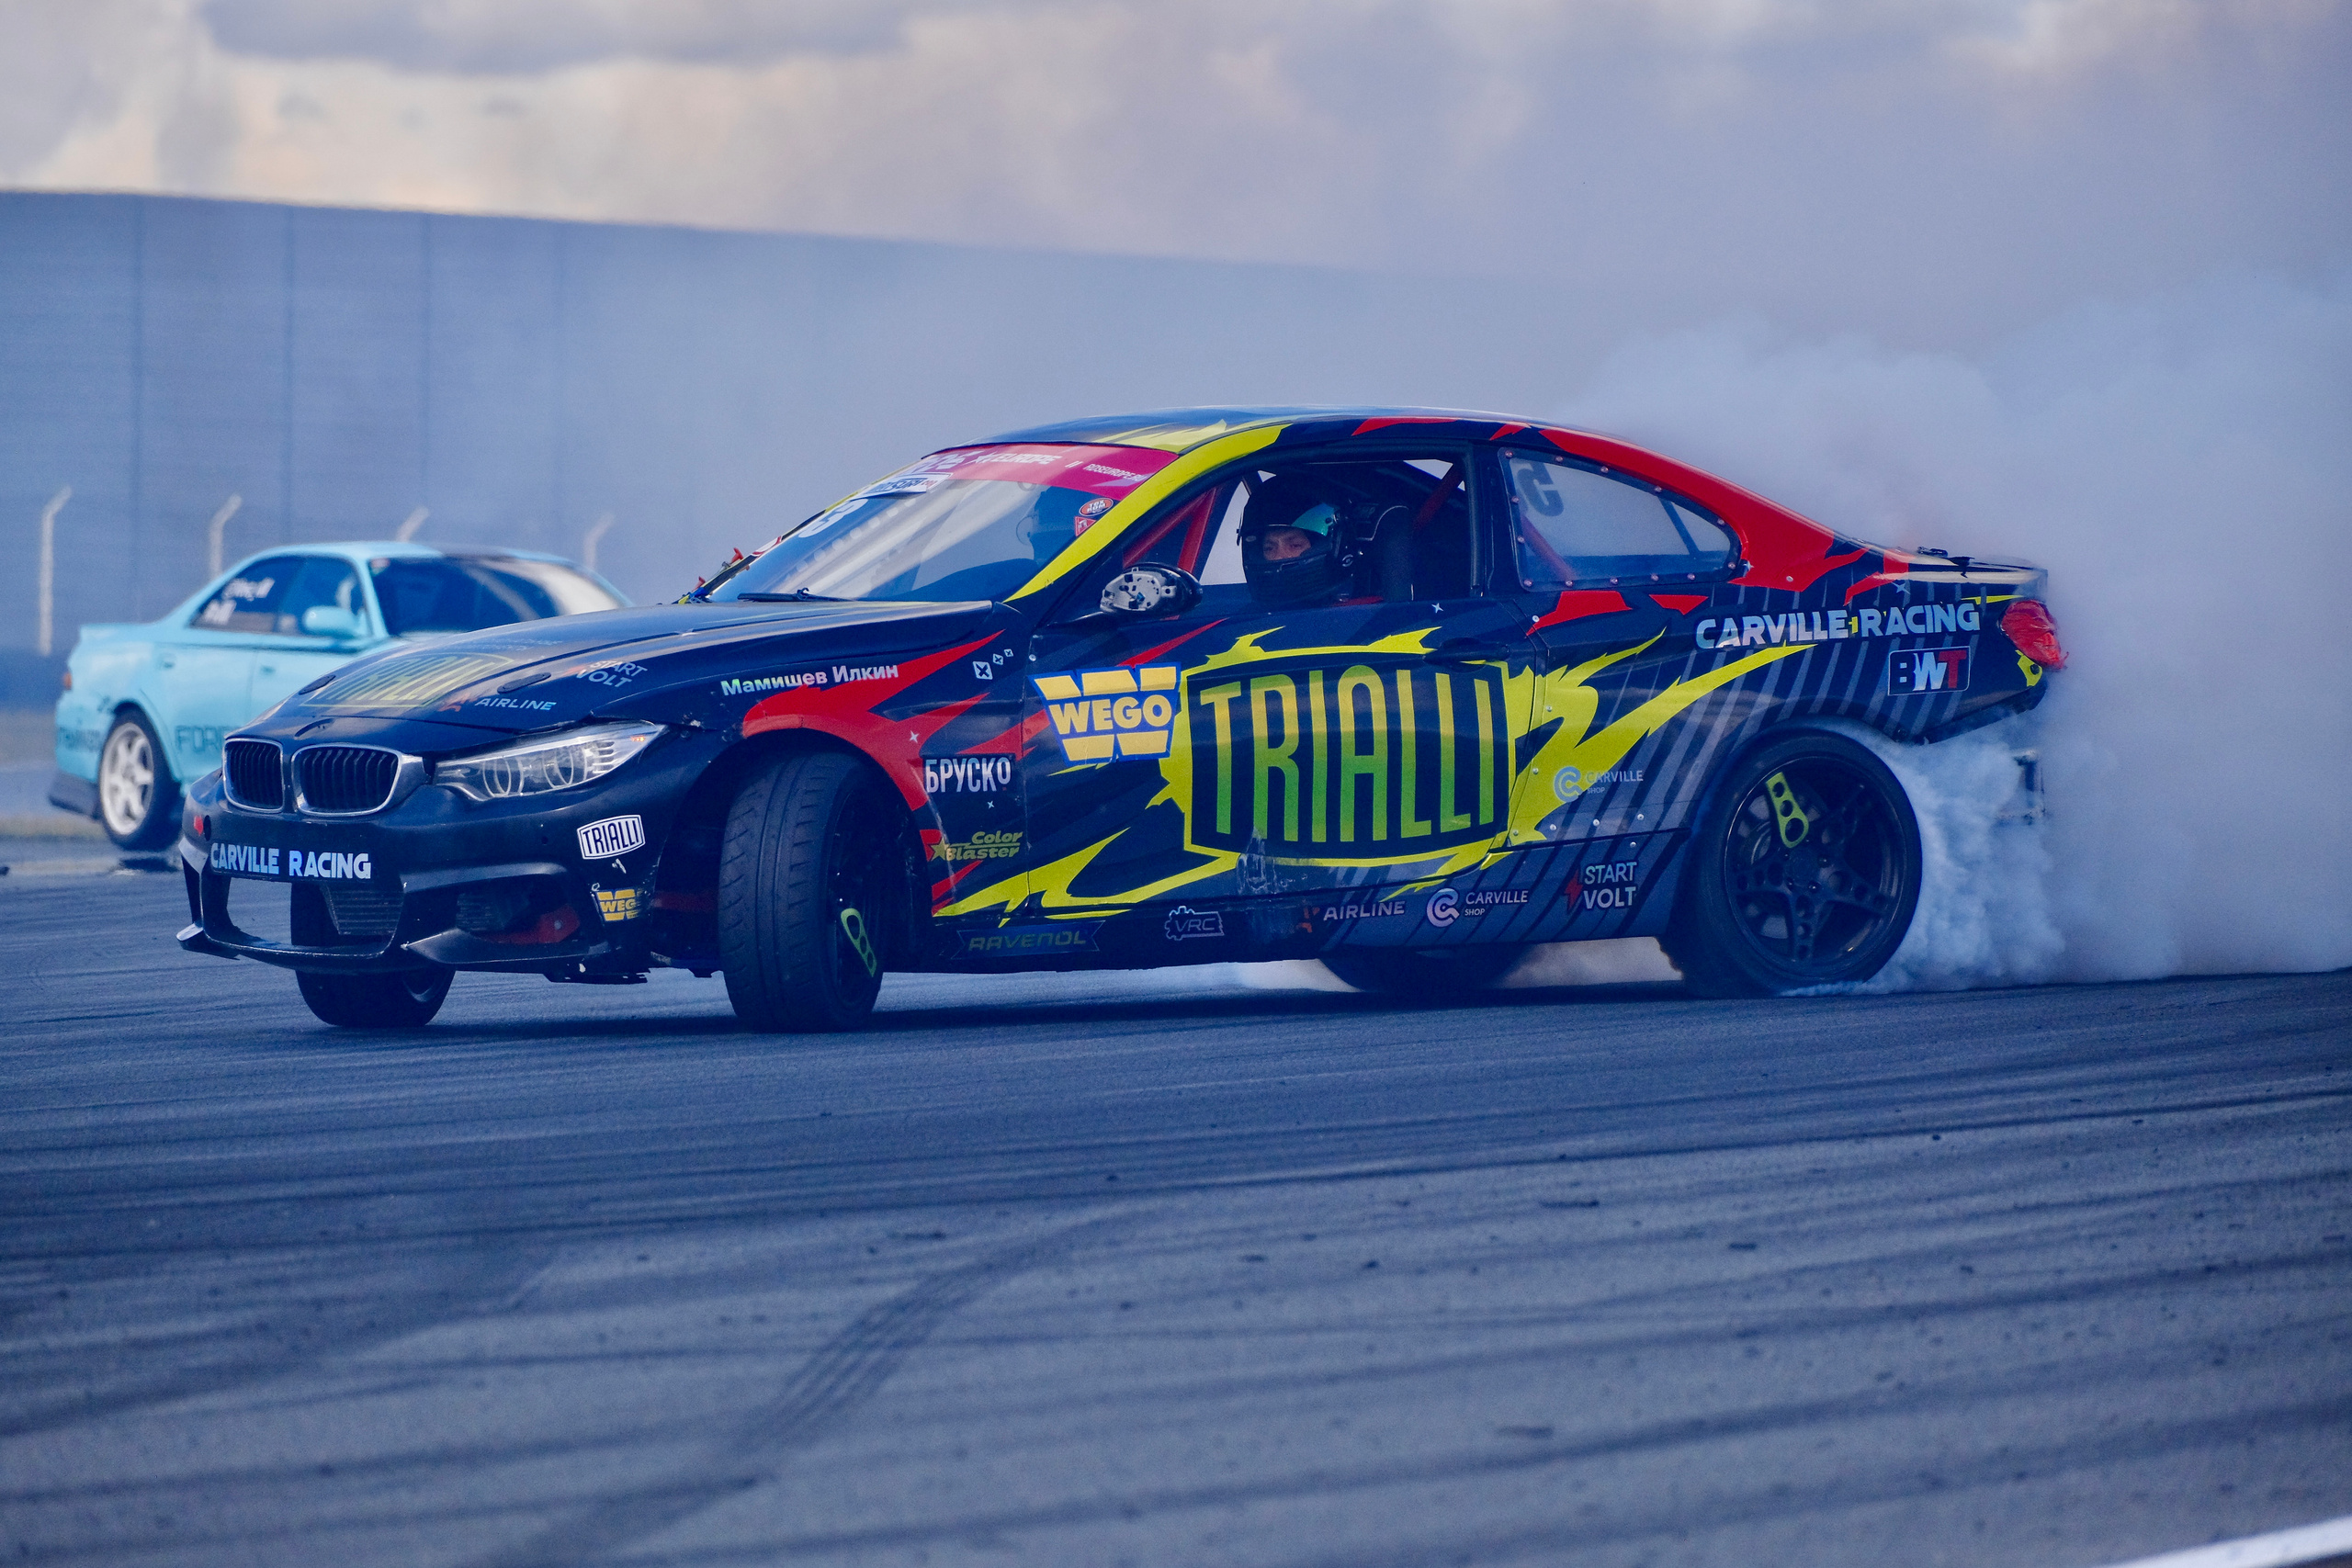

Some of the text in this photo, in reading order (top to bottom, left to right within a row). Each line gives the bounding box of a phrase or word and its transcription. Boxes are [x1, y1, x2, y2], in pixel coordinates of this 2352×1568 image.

[1696, 603, 1981, 649] CARVILLE RACING
[575, 669, 633, 688] VOLT
[589, 660, 649, 677] START
[1896, 650, 1967, 692] BWT
[720, 664, 899, 696] Мамишев Илкин
[474, 697, 557, 711] AIRLINE
[1049, 694, 1173, 736] WEGO
[1200, 664, 1495, 843] TRIALLI
[924, 756, 1012, 794] БРУСКО
[1586, 770, 1644, 784] CARVILLE
[1587, 786, 1606, 795] SHOP
[582, 820, 642, 855] TRIALLI
[971, 830, 1023, 845] Color
[210, 842, 371, 880] CARVILLE RACING
[945, 841, 1020, 861] Blaster
[1583, 862, 1637, 886] START
[599, 898, 641, 912] WEG
[1464, 889, 1529, 905] CARVILLE
[1583, 886, 1637, 909] VOLT
[1324, 900, 1406, 921] AIRLINE
[1464, 908, 1486, 917] SHOP
[1175, 918, 1216, 932] VRC
[968, 931, 1087, 952] RAVENOL
